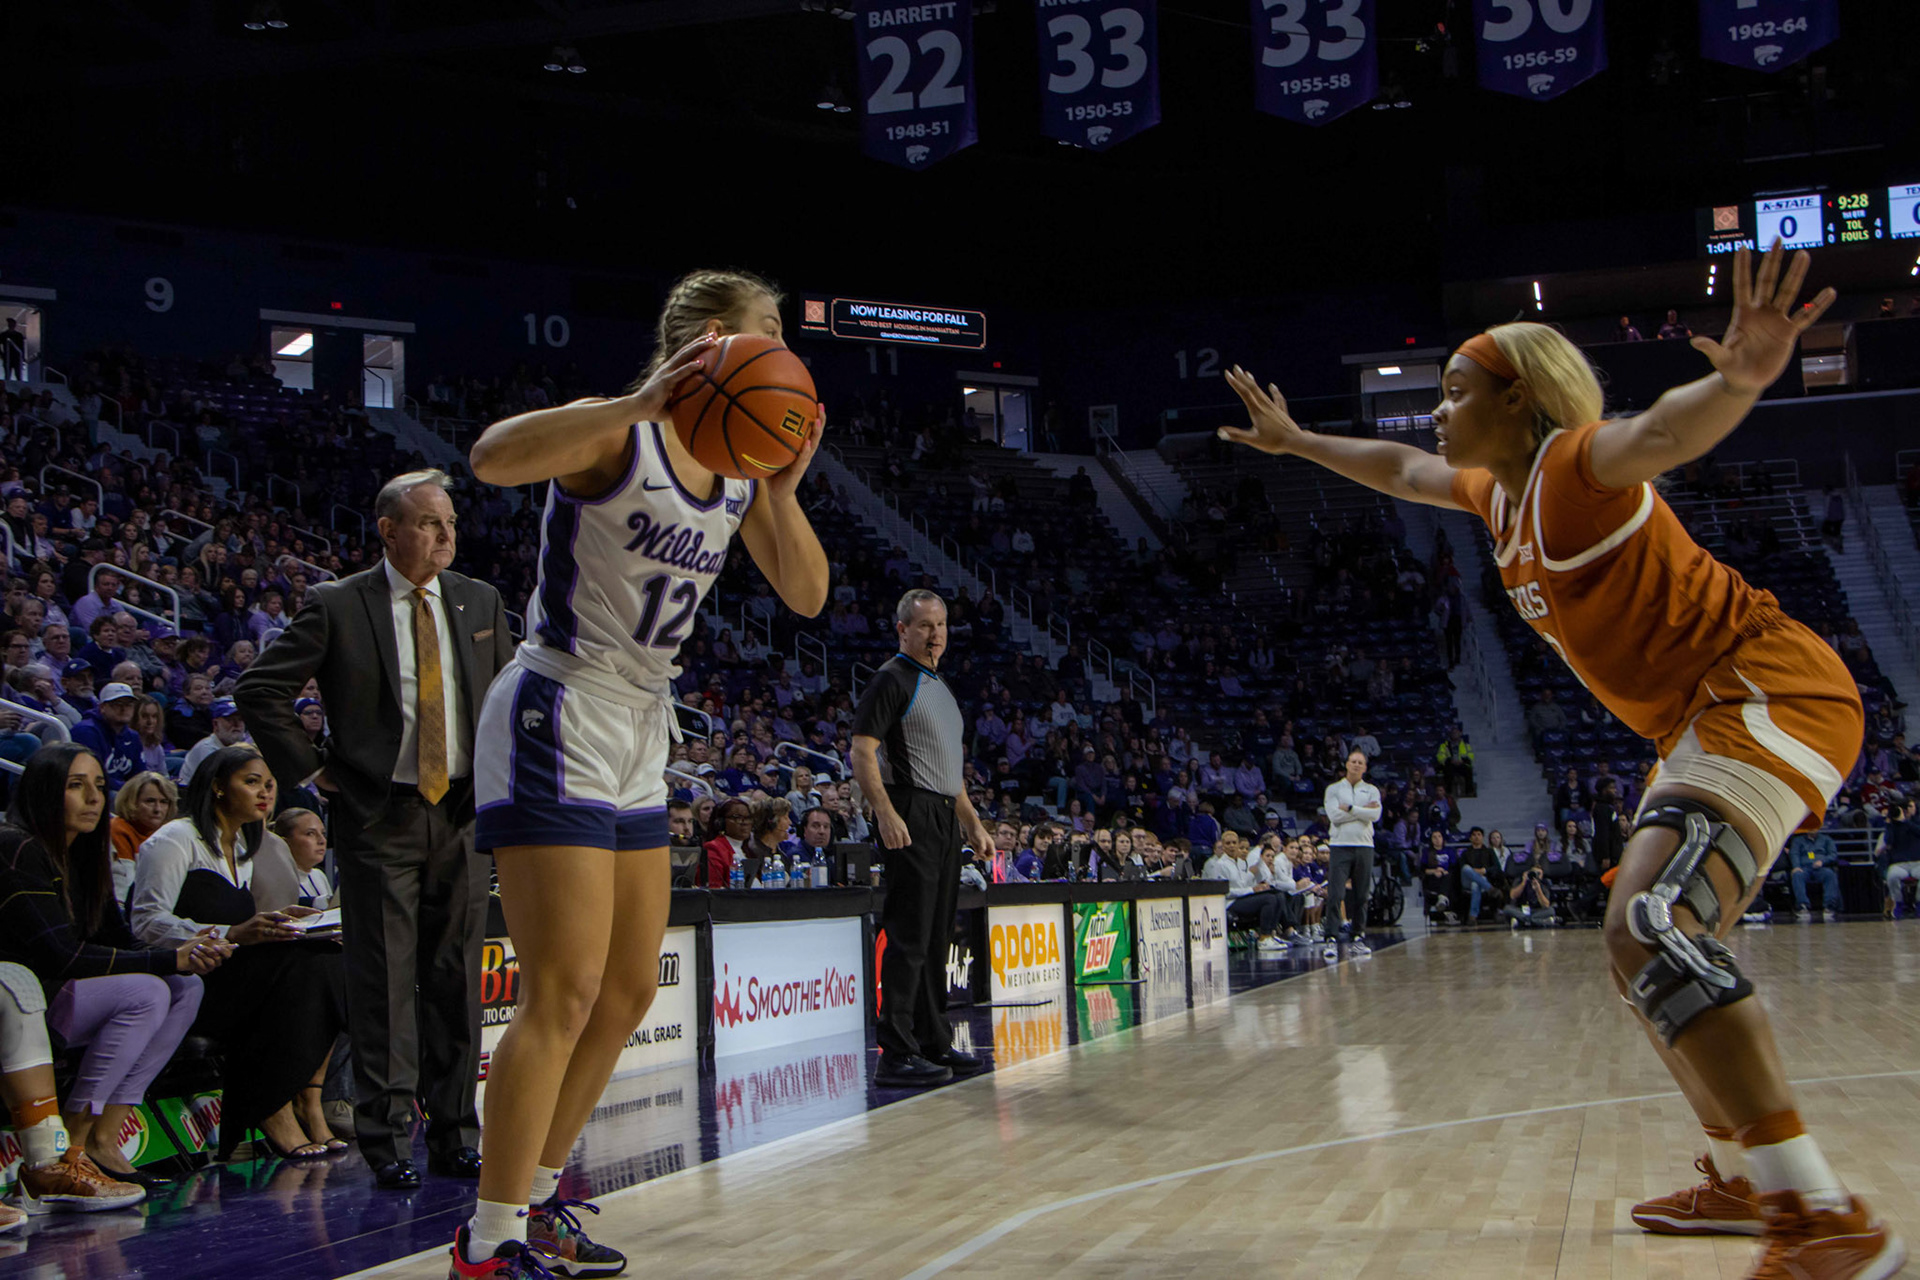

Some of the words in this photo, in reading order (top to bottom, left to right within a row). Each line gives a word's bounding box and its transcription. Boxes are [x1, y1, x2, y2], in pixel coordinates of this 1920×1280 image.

[868, 3, 957, 28] BARRETT
[1261, 0, 1367, 68] 33
[1728, 16, 1808, 41] 1962-64
[1047, 7, 1148, 94] 33
[1502, 46, 1578, 70] 1956-59
[866, 29, 966, 114] 22
[1280, 73, 1351, 95] 1955-58
[1065, 101, 1133, 121] 1950-53
[886, 121, 950, 141] 1948-51
[1763, 198, 1814, 210] K-STATE
[1837, 193, 1869, 210] 9:28
[1779, 215, 1798, 238] 0
[1841, 229, 1869, 242] FOULS
[1846, 220, 1863, 230] TOL
[1706, 242, 1733, 254] 1:04
[1734, 239, 1755, 251] PM
[145, 277, 175, 313] 9
[850, 304, 878, 317] NOW
[878, 307, 922, 321] LEASING
[922, 311, 944, 323] FOR
[944, 314, 969, 326] FALL
[523, 313, 570, 348] 10
[893, 323, 919, 331] HOUSING
[926, 326, 960, 334] MANHATTAN
[865, 344, 898, 376] 11
[1173, 347, 1220, 379] 12
[632, 573, 699, 649] 12
[1150, 904, 1181, 931] Ascension
[1211, 917, 1223, 939] BELL
[990, 922, 1060, 988] QDOBA
[945, 942, 975, 993] Hut
[1007, 970, 1041, 989] MEXICAN
[1043, 967, 1060, 982] EATS
[746, 976, 822, 1022] SMOOTHIE
[654, 1023, 682, 1042] GRADE
